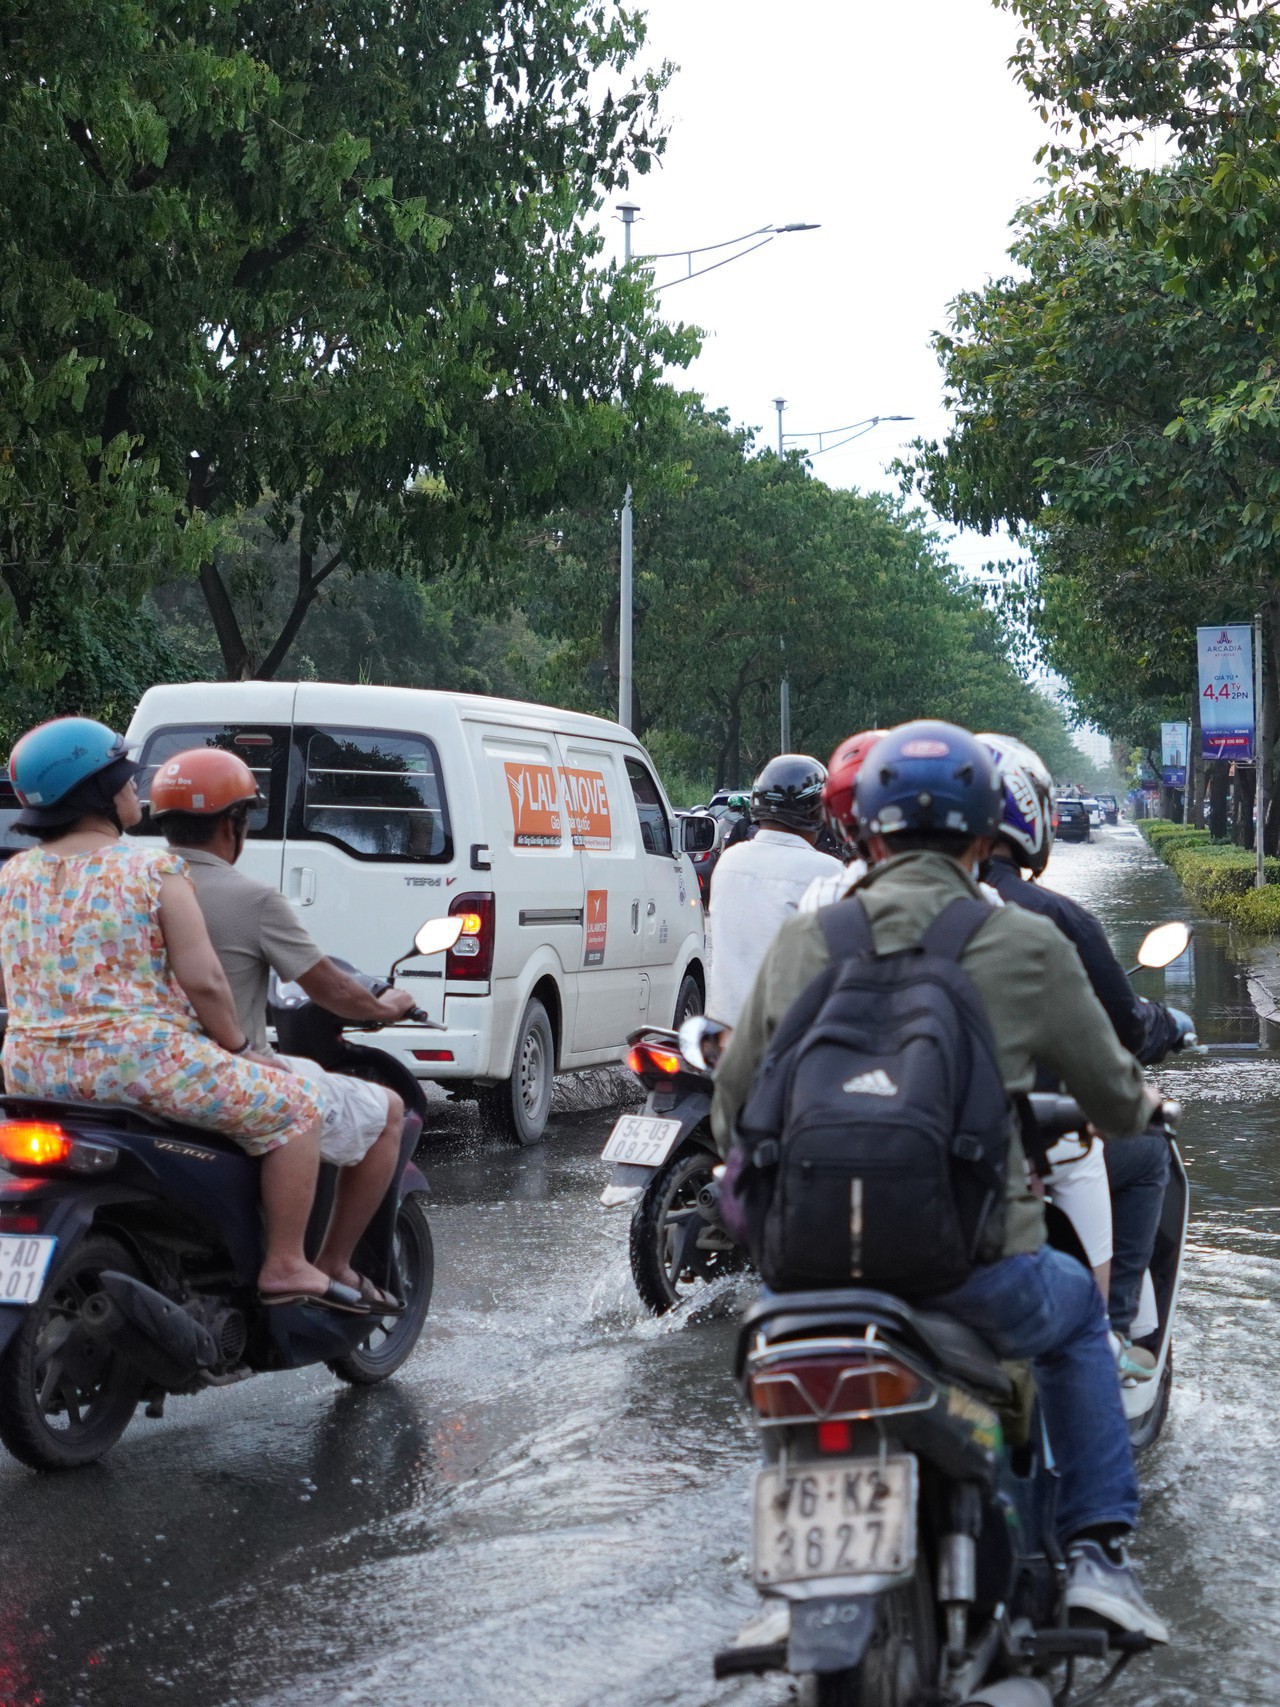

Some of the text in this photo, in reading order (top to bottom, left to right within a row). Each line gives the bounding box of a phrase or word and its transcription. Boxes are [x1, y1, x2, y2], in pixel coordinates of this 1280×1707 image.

[1203, 683, 1230, 702] 4,4
[526, 772, 608, 815] LALAMOVE
[446, 877, 457, 887] V
[613, 1140, 661, 1161] 0877
[0, 1240, 40, 1267] -AD
